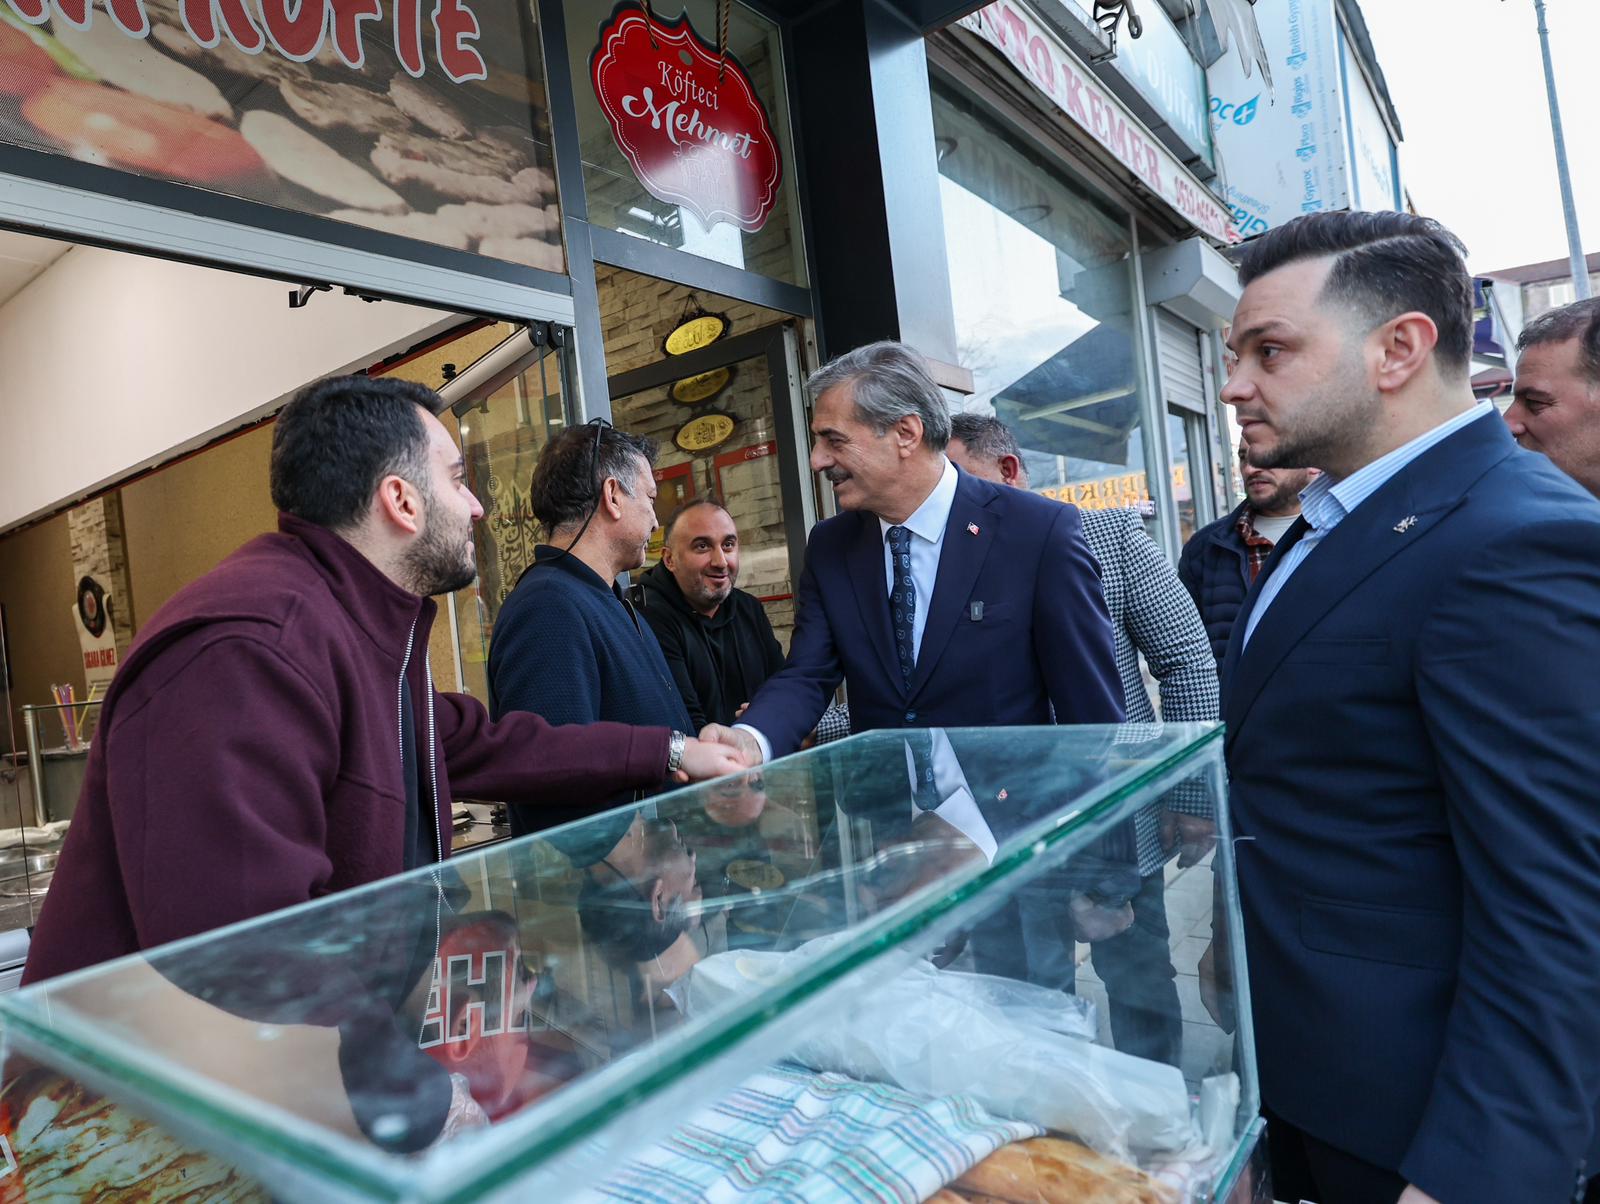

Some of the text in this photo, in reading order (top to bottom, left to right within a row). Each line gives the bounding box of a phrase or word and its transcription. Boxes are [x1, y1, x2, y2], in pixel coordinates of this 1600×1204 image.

[622, 86, 759, 160] Mehmet
[657, 61, 719, 111] Köfteci
[1062, 64, 1163, 191] KEMER
